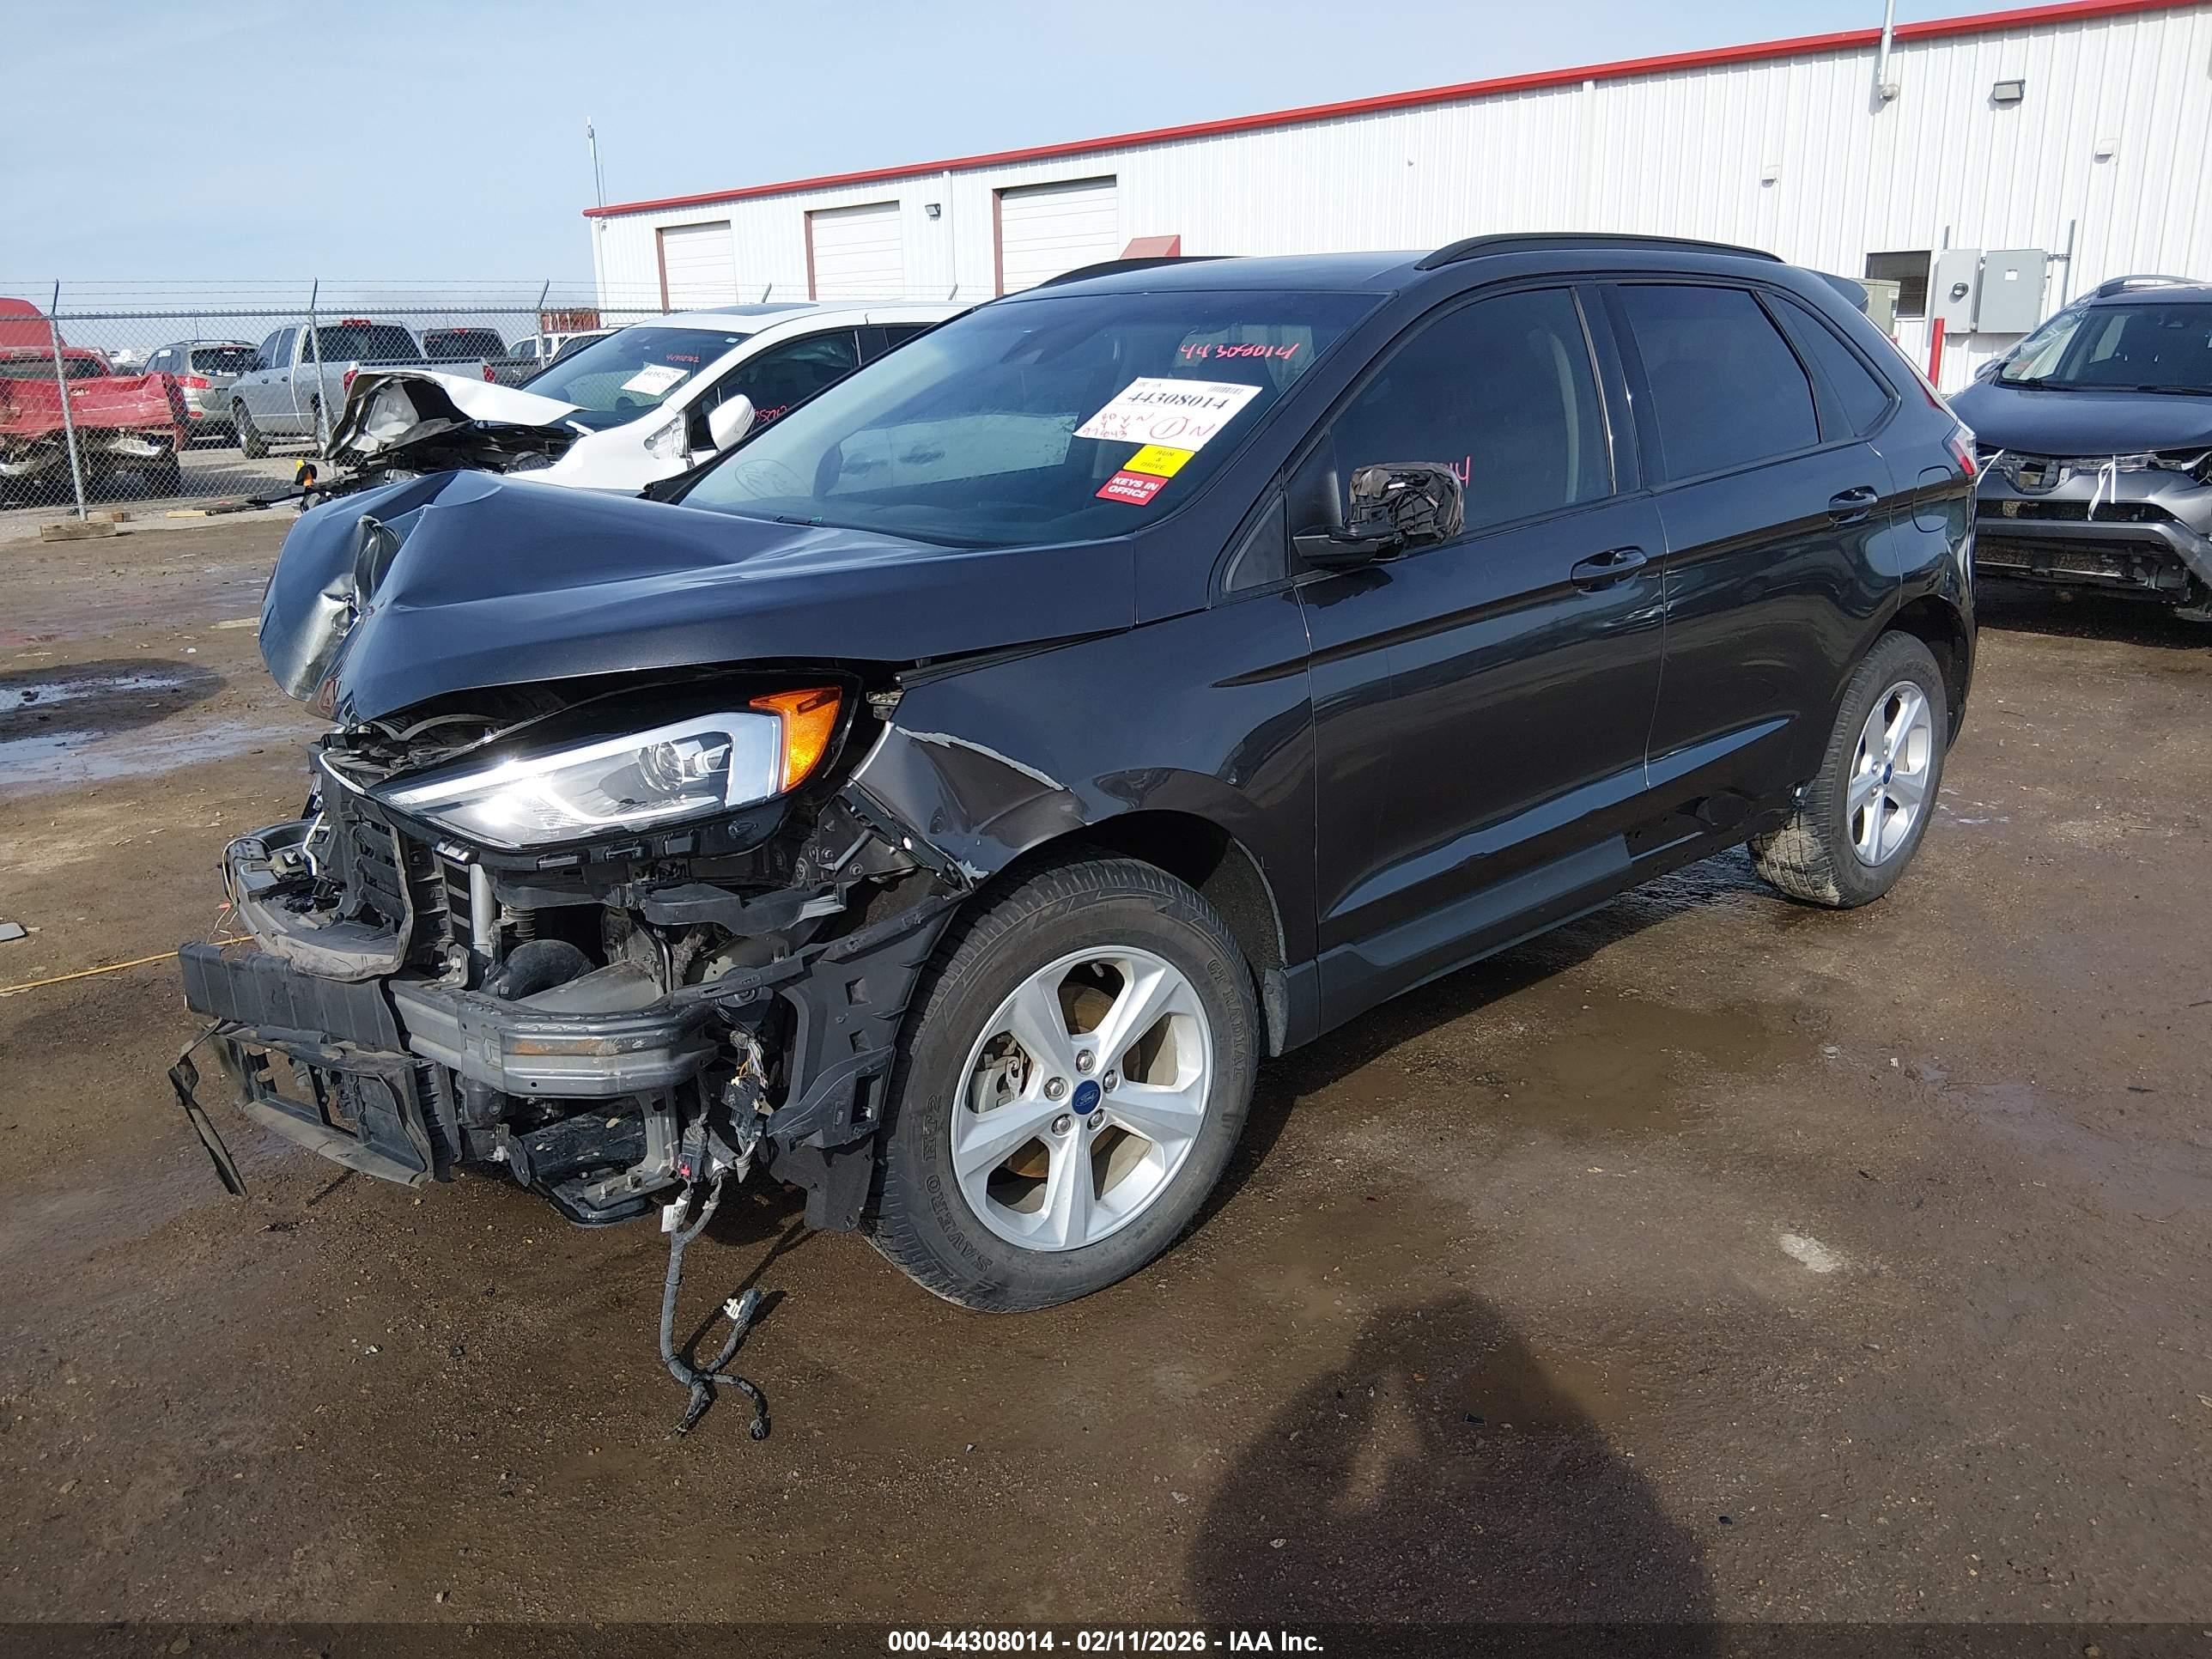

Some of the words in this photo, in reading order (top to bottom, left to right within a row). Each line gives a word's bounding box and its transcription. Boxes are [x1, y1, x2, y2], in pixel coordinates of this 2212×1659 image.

[1127, 392, 1230, 410] 44308014
[1140, 462, 1167, 471] DRIVE
[1108, 485, 1149, 499] OFFICE
[1112, 477, 1144, 488] KEYS
[1144, 482, 1159, 491] IN
[1206, 959, 1231, 983] GT
[1222, 988, 1245, 1082] RADIAL
[926, 1175, 993, 1273] SAVERO
